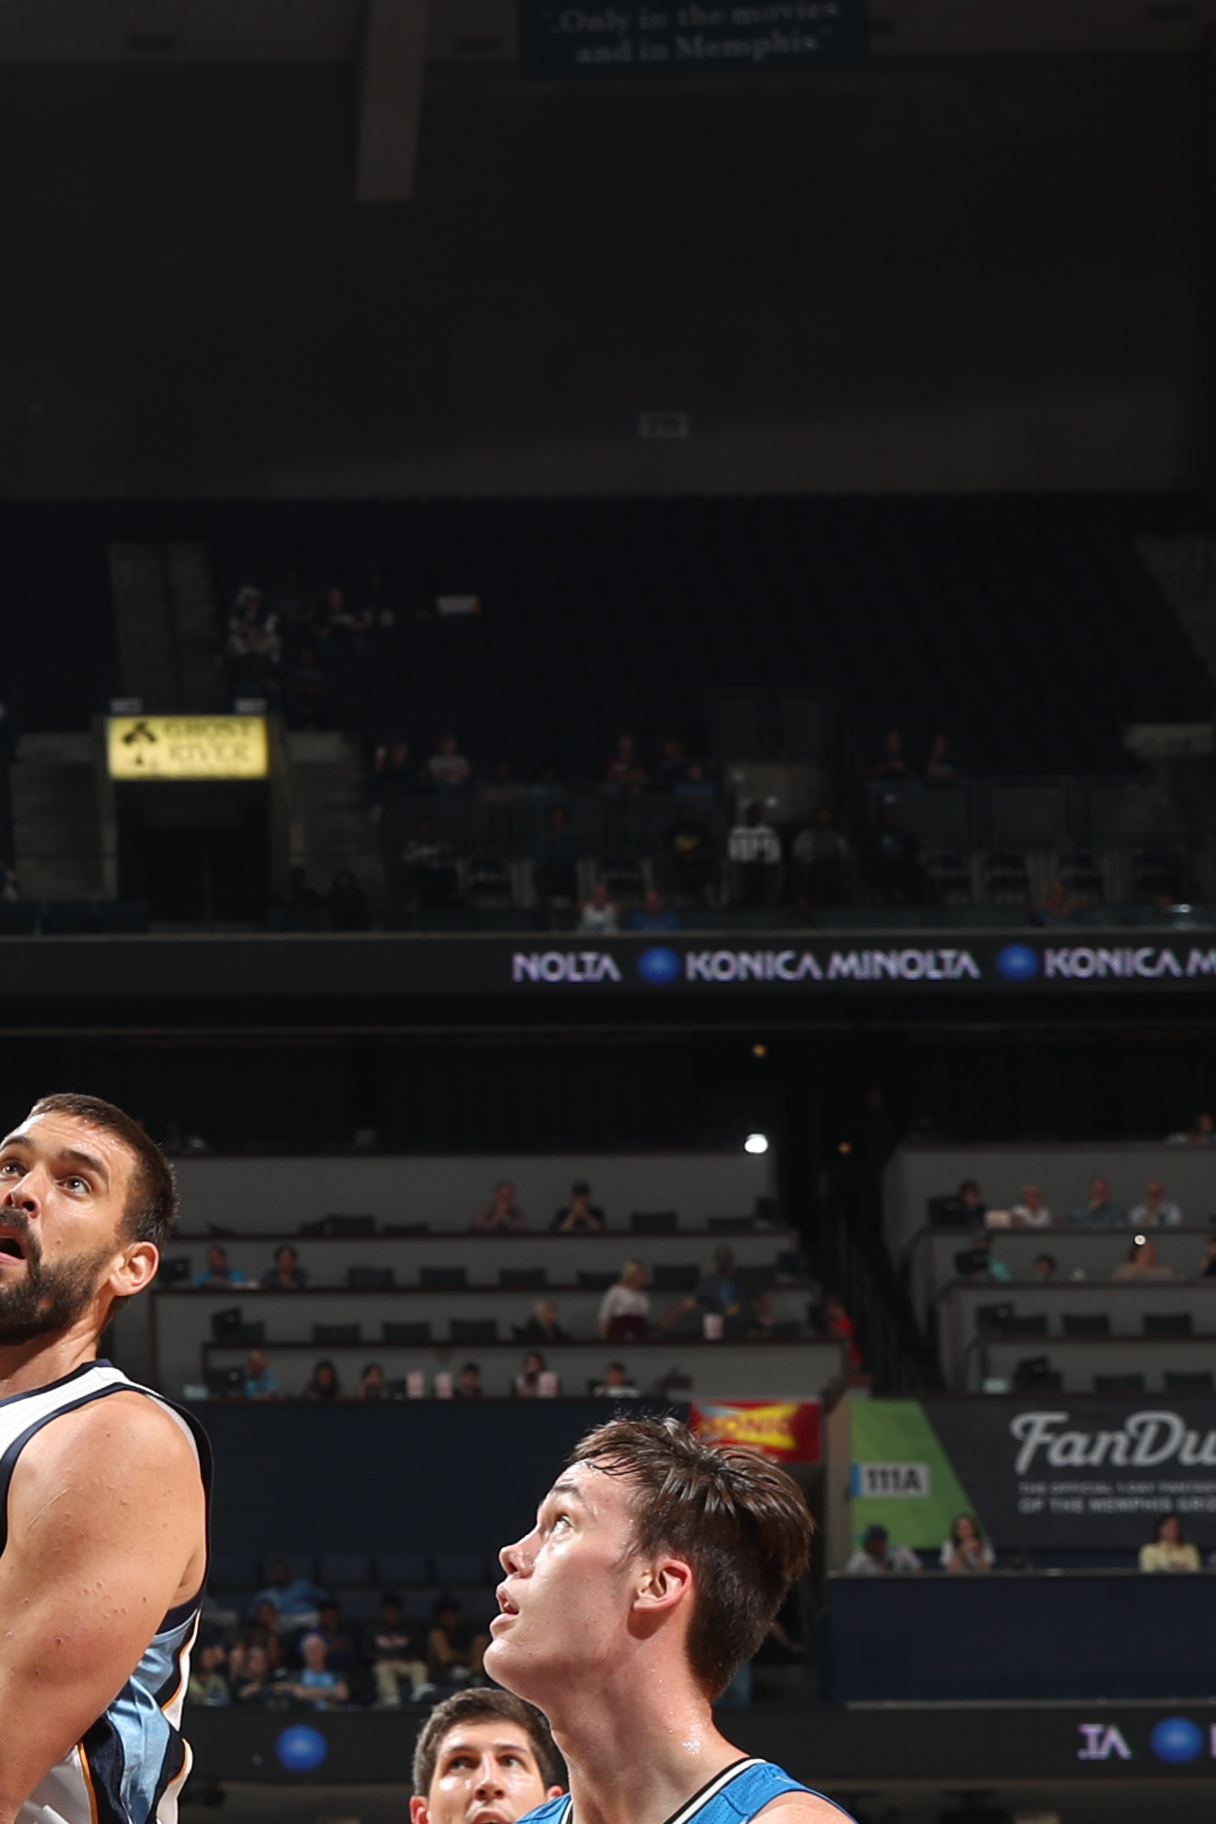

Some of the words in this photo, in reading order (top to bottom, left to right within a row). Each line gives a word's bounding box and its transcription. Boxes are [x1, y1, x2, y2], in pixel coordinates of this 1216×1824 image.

[575, 40, 632, 64] and
[512, 951, 622, 983] NOLTA
[686, 950, 823, 982] KONICA
[827, 949, 981, 981] MINOLTA
[1044, 947, 1182, 979] KONICA
[868, 1469, 922, 1492] 111A
